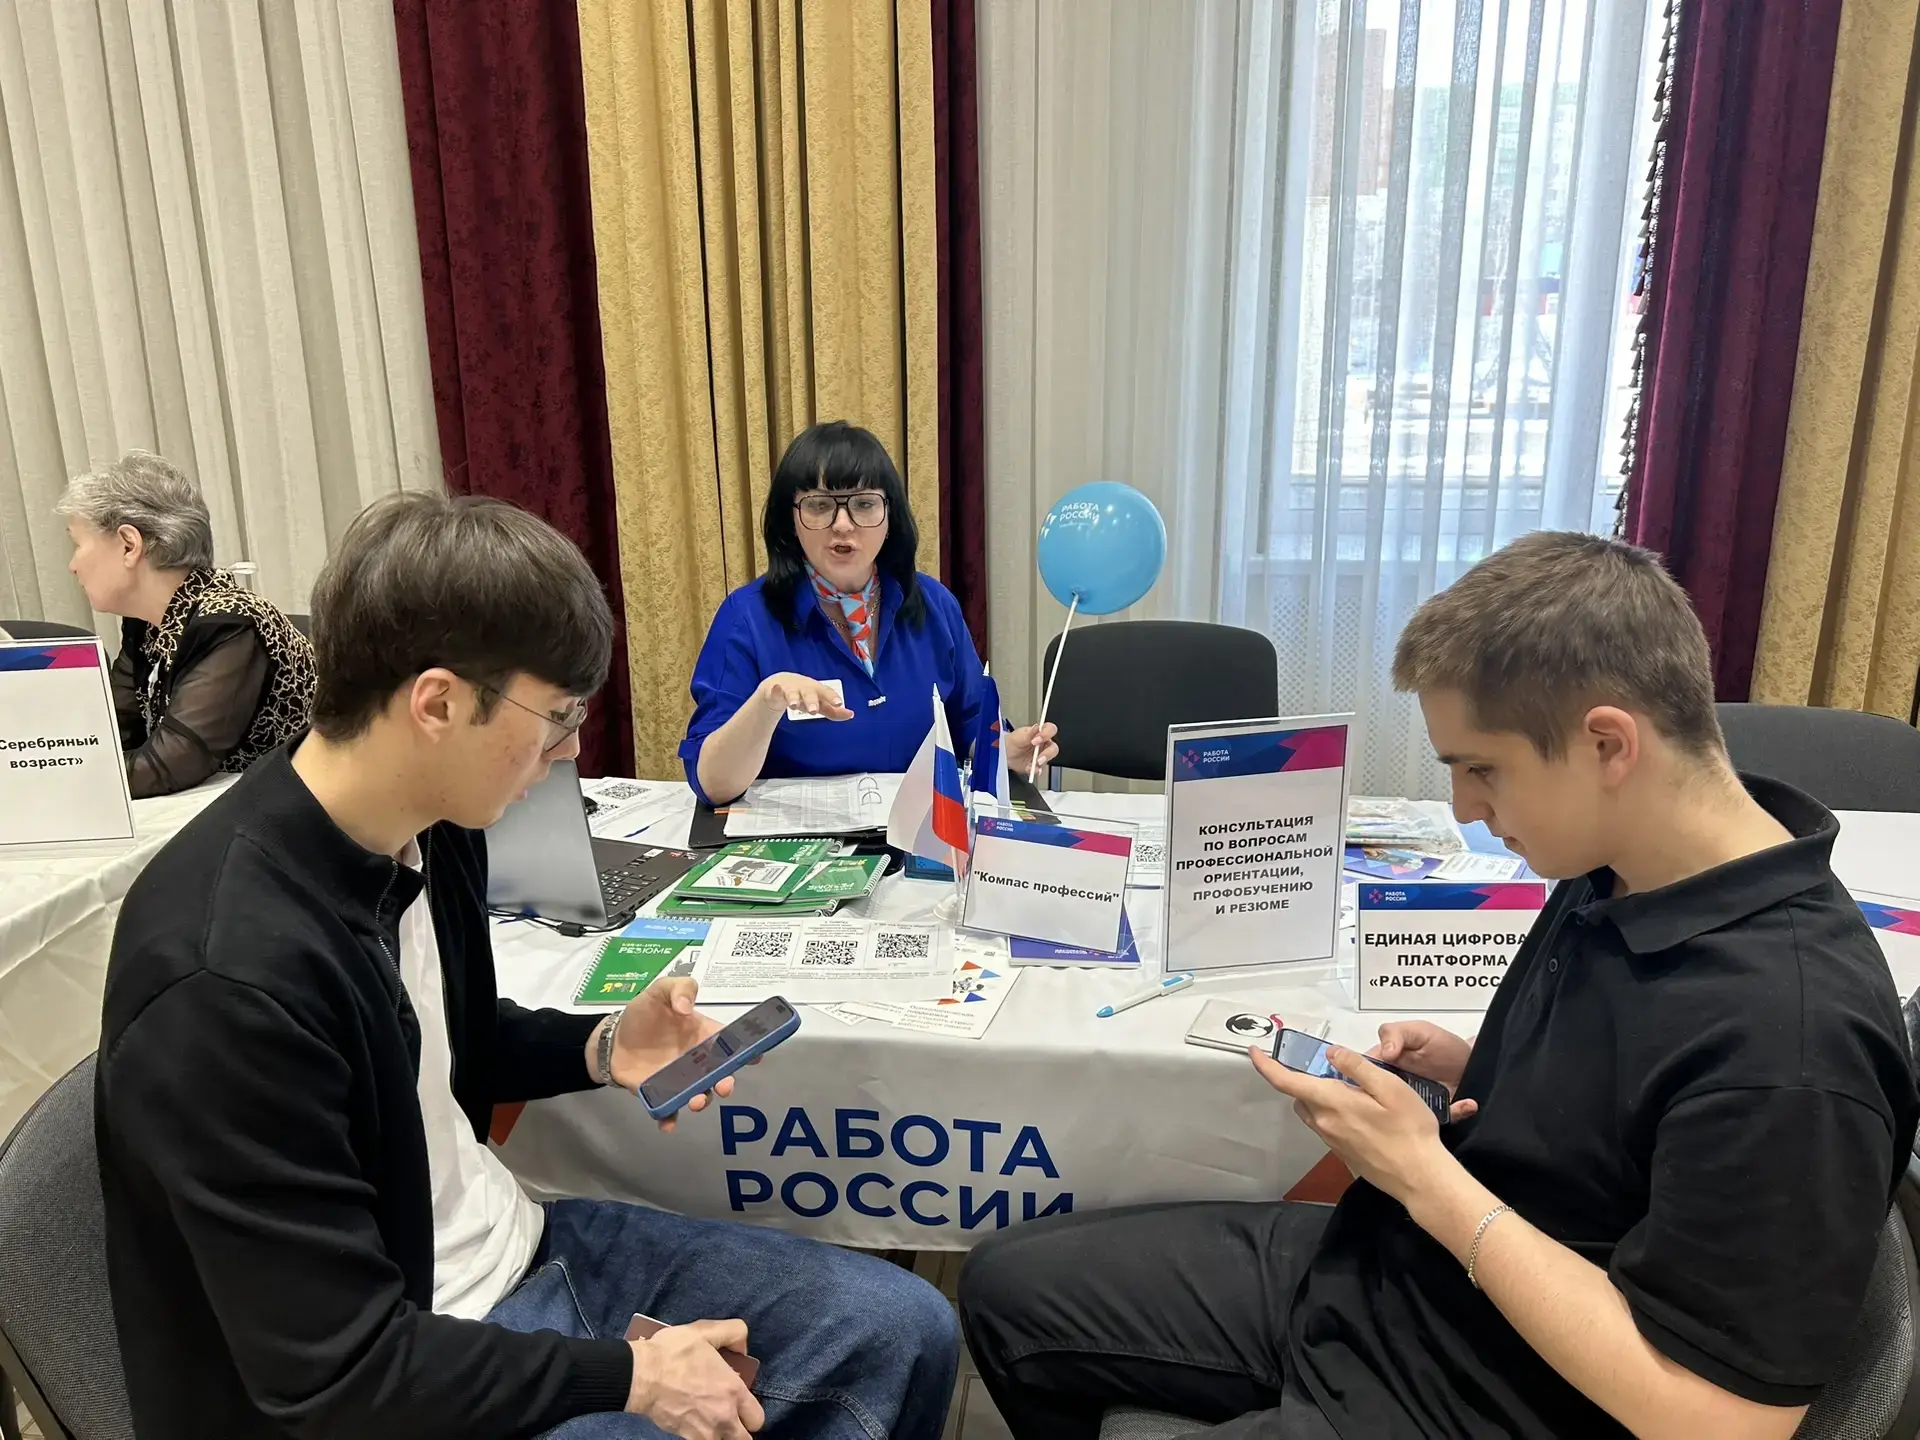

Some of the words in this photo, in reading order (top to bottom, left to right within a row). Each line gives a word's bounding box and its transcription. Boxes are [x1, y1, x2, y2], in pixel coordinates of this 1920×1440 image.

[1061, 502, 1099, 512] РАБОТА
[0, 734, 99, 751] Серебряный
[10, 757, 83, 769] возраст»
[1199, 815, 1314, 836] КОНСУЛЬТАЦИЯ
[1204, 841, 1224, 852] ПО
[1228, 833, 1307, 849] ВОПРОСАМ
[1176, 845, 1333, 870] ПРОФЕССИОНАЛЬНОЙ
[1204, 866, 1304, 884] ОРИЕНТАЦИИ,
[974, 871, 1029, 889] "Компас
[1033, 881, 1119, 903] профессий"
[1193, 881, 1313, 901] ПРОФОБУЧЕНИЮ
[1215, 905, 1225, 915] И
[1230, 899, 1289, 913] РЕЗЮМЕ
[1365, 933, 1436, 947] ЕДИНАЯ
[1442, 933, 1527, 947] ЦИФРОВА
[1397, 955, 1508, 966] ПЛАТФОРМА
[1369, 976, 1449, 987] «РАБОТА
[1455, 976, 1504, 987] РОСС
[719, 1105, 1060, 1179] РАБОТА
